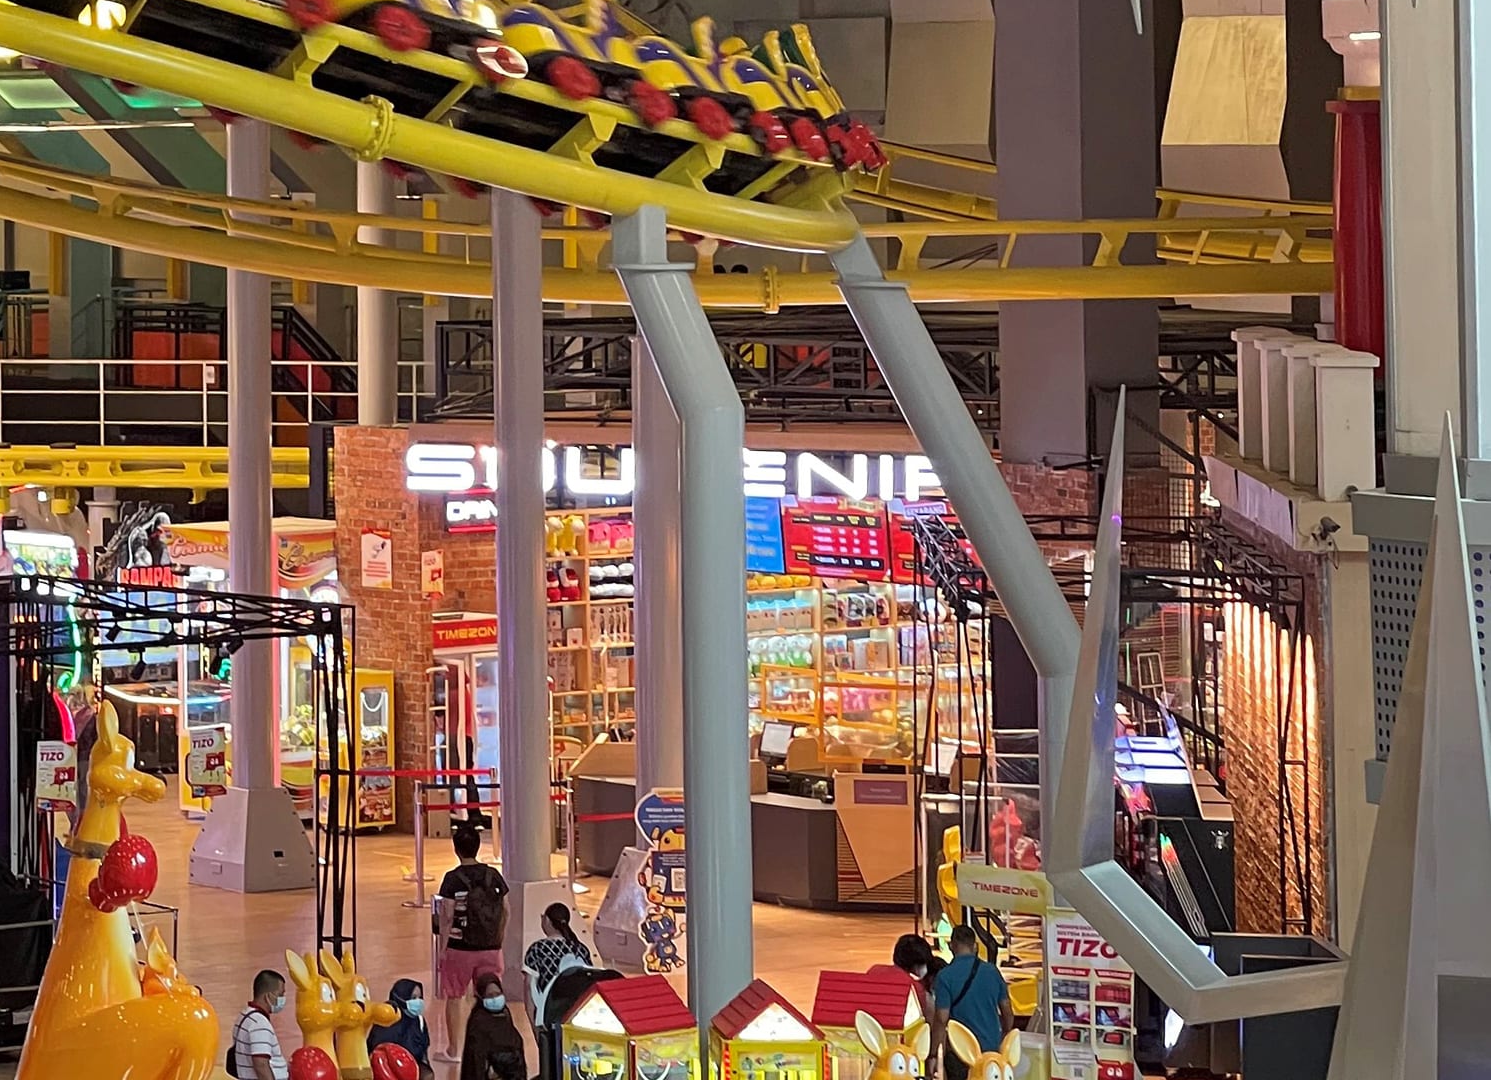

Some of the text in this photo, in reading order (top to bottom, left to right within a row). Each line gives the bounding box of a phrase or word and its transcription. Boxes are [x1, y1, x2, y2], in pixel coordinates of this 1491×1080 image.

[406, 443, 942, 502] SUENI
[120, 566, 180, 588] RAMPA
[436, 626, 497, 640] TIMEZON
[191, 738, 215, 749] TIZO
[39, 751, 65, 762] TIZO
[971, 881, 1039, 898] TIMEZONE
[1057, 938, 1119, 959] TIZO
